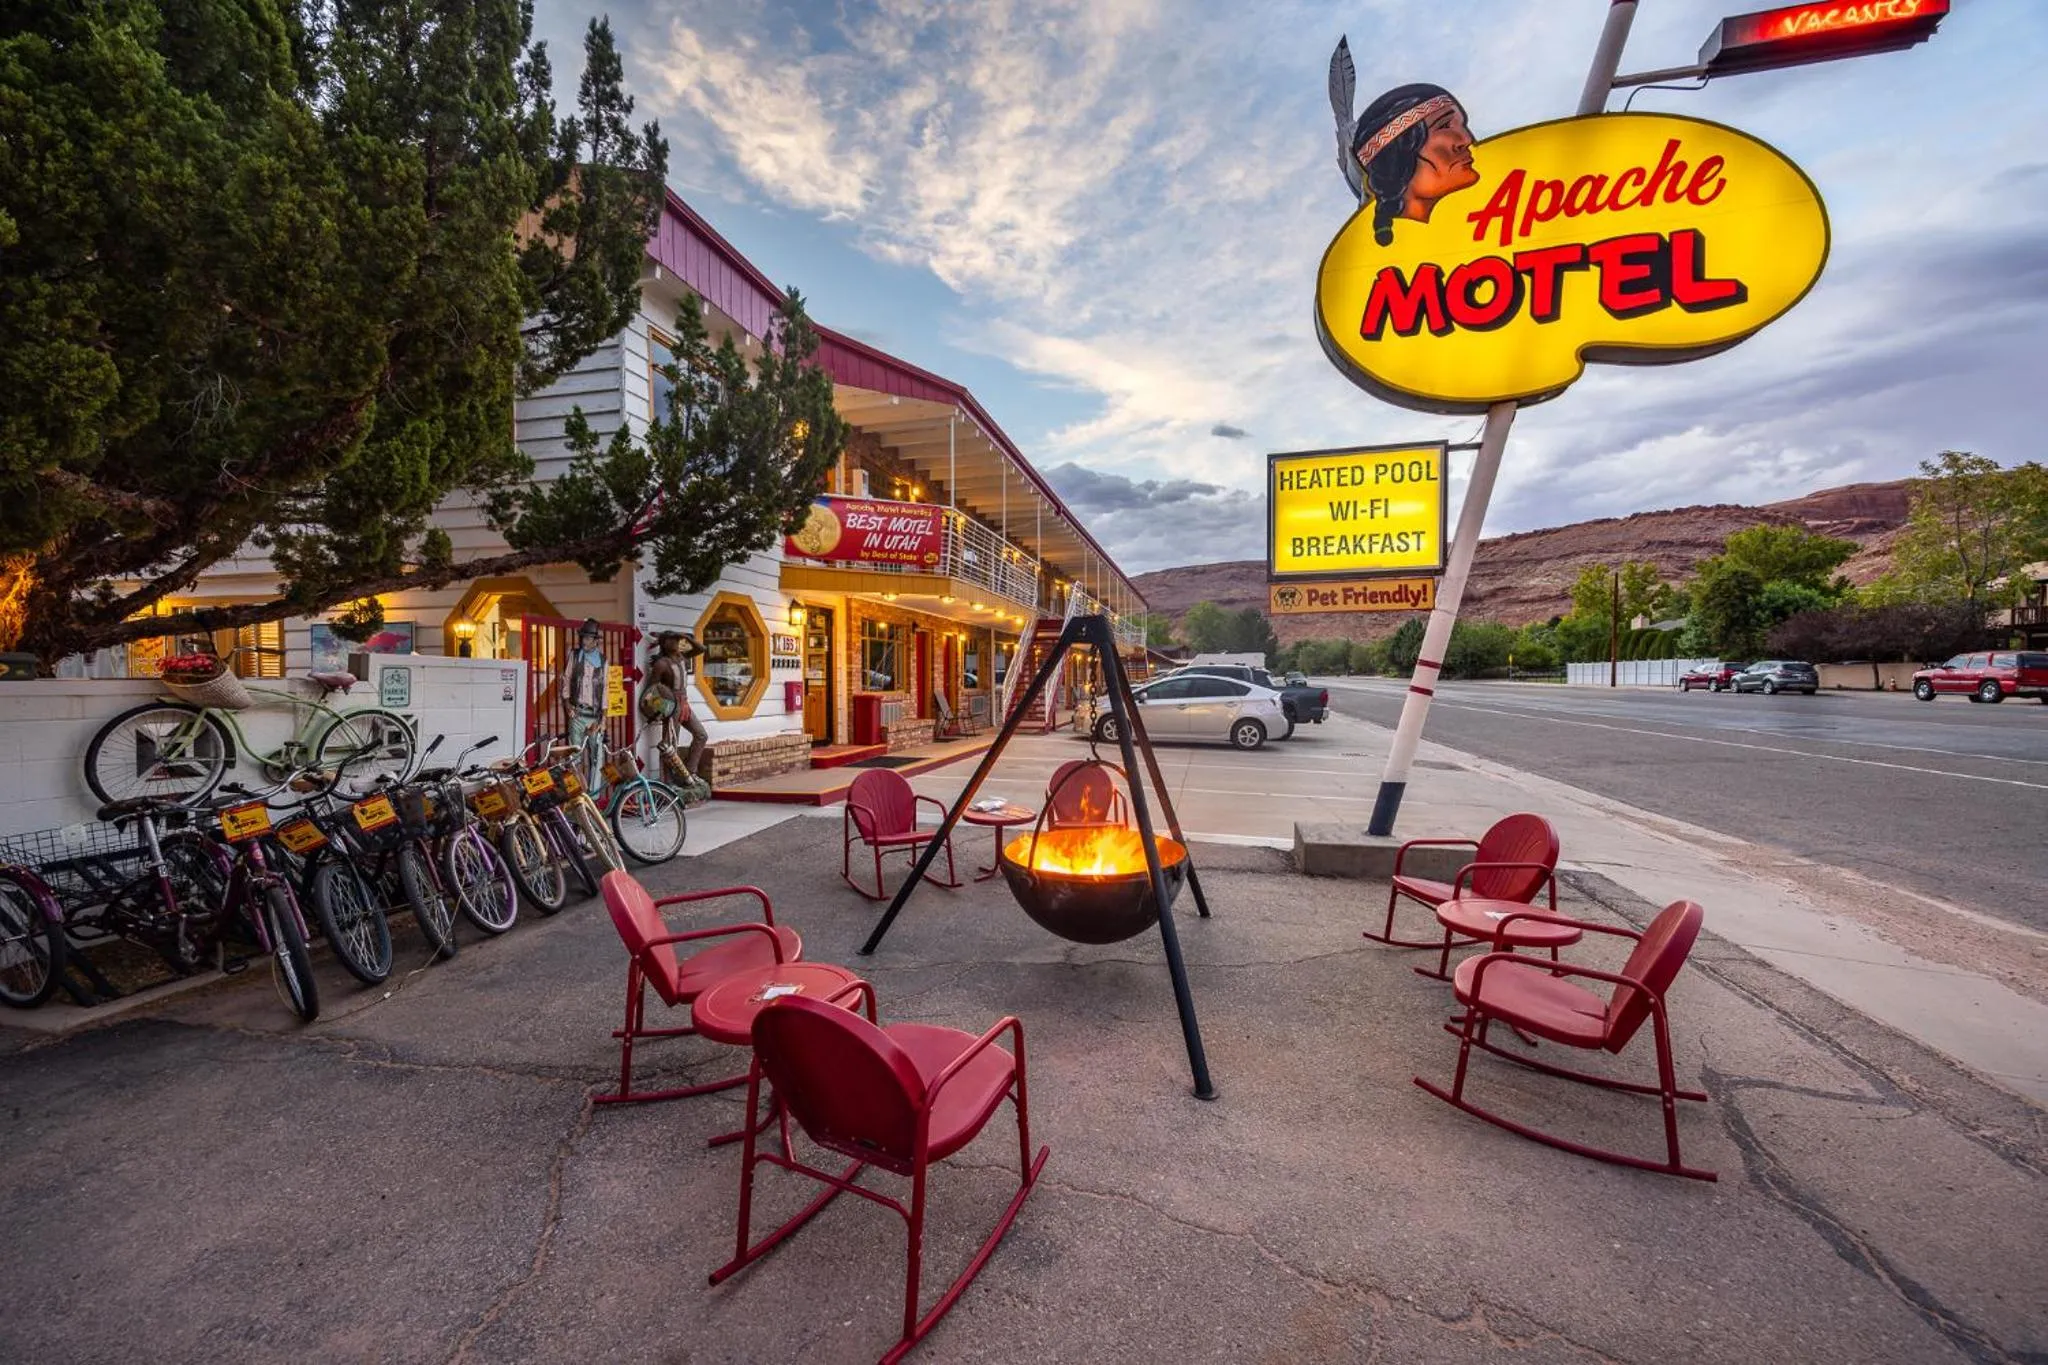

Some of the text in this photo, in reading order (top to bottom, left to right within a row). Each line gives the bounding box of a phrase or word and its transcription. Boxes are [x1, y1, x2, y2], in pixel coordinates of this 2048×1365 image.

[1466, 138, 1727, 247] Apache
[1360, 228, 1748, 340] MOTEL
[1279, 460, 1439, 491] HEATED POOL
[1328, 498, 1390, 522] WI-FI
[846, 512, 933, 535] BEST MOTEL
[863, 532, 921, 551] IN UTAH
[1291, 531, 1426, 558] BREAKFAST
[1306, 584, 1429, 607] Pet Friendly!
